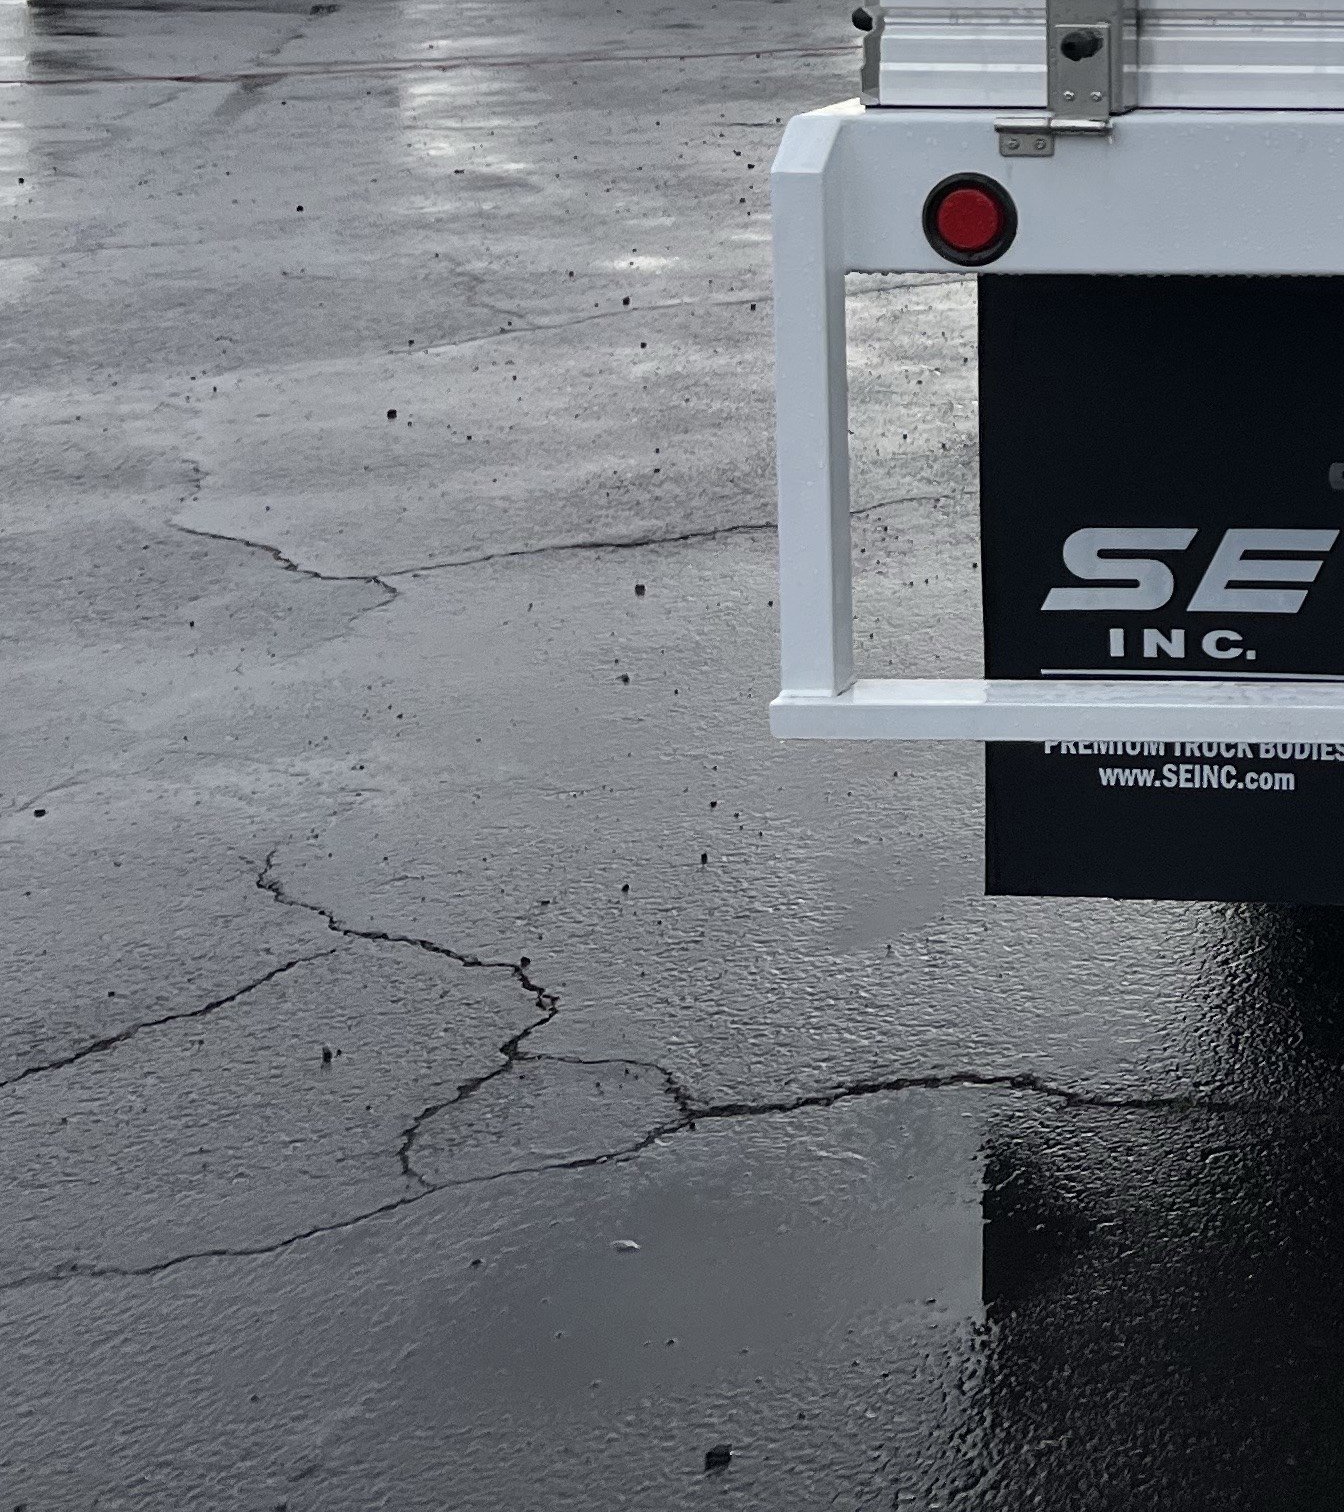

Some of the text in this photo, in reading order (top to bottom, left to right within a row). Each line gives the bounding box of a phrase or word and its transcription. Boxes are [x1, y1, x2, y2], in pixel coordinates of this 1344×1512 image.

[1040, 527, 1341, 614] SE
[1108, 627, 1257, 660] INC.
[1043, 740, 1165, 756] PREMIUM
[1172, 741, 1254, 759] TRUCK
[1098, 763, 1296, 791] www.SEINC.com
